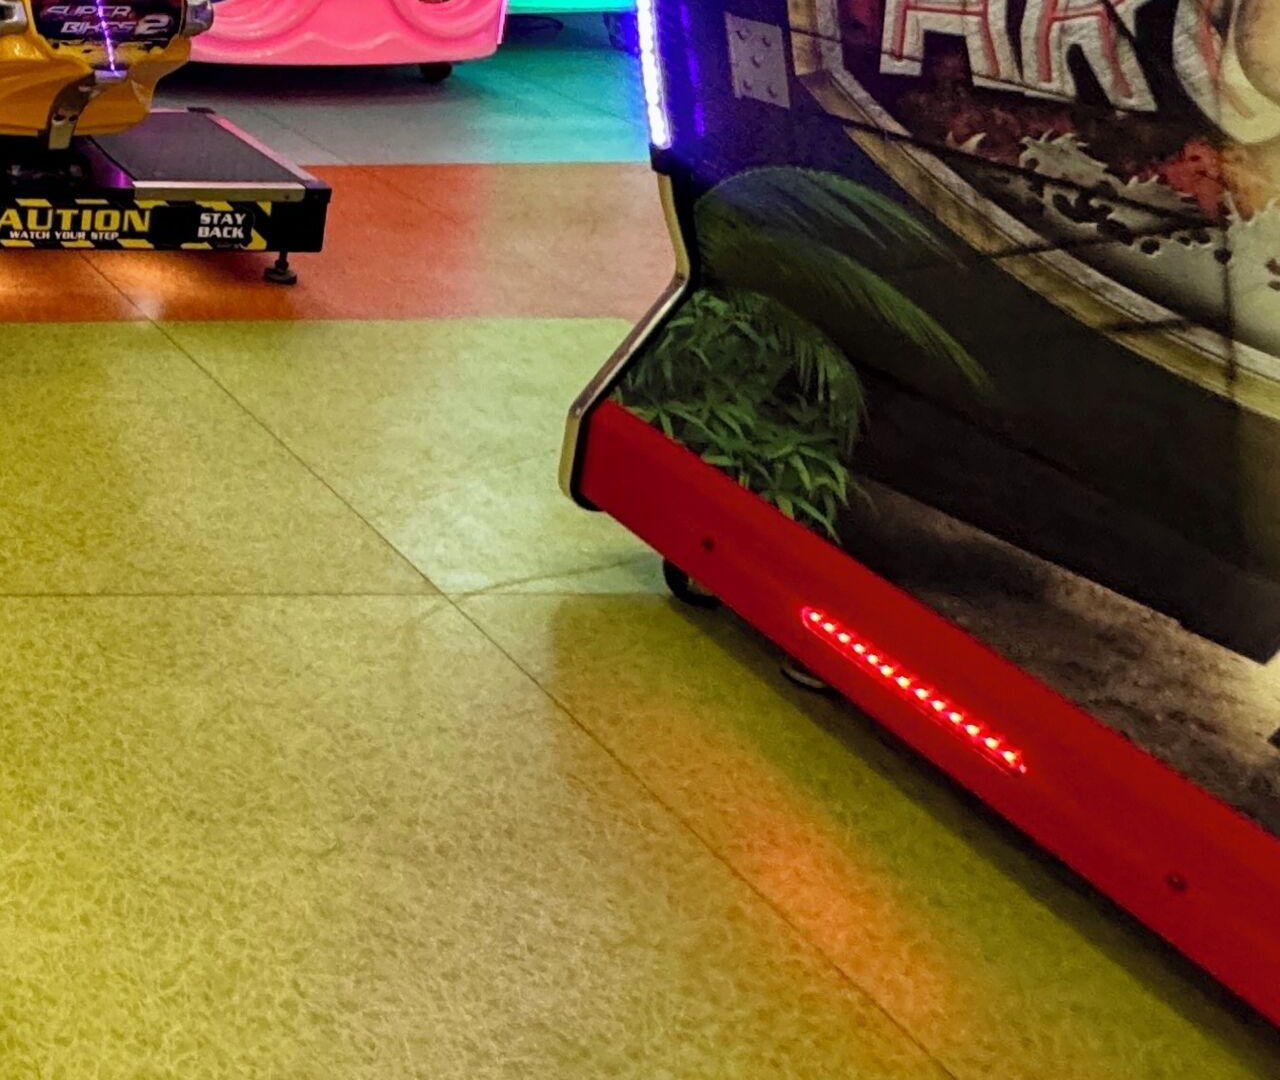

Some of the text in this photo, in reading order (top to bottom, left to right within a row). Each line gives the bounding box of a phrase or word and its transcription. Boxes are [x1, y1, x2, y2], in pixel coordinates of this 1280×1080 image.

[135, 14, 171, 35] 2
[200, 212, 246, 225] STAY
[9, 231, 120, 240] WATCH YOUR STEP
[197, 226, 244, 238] BACK
